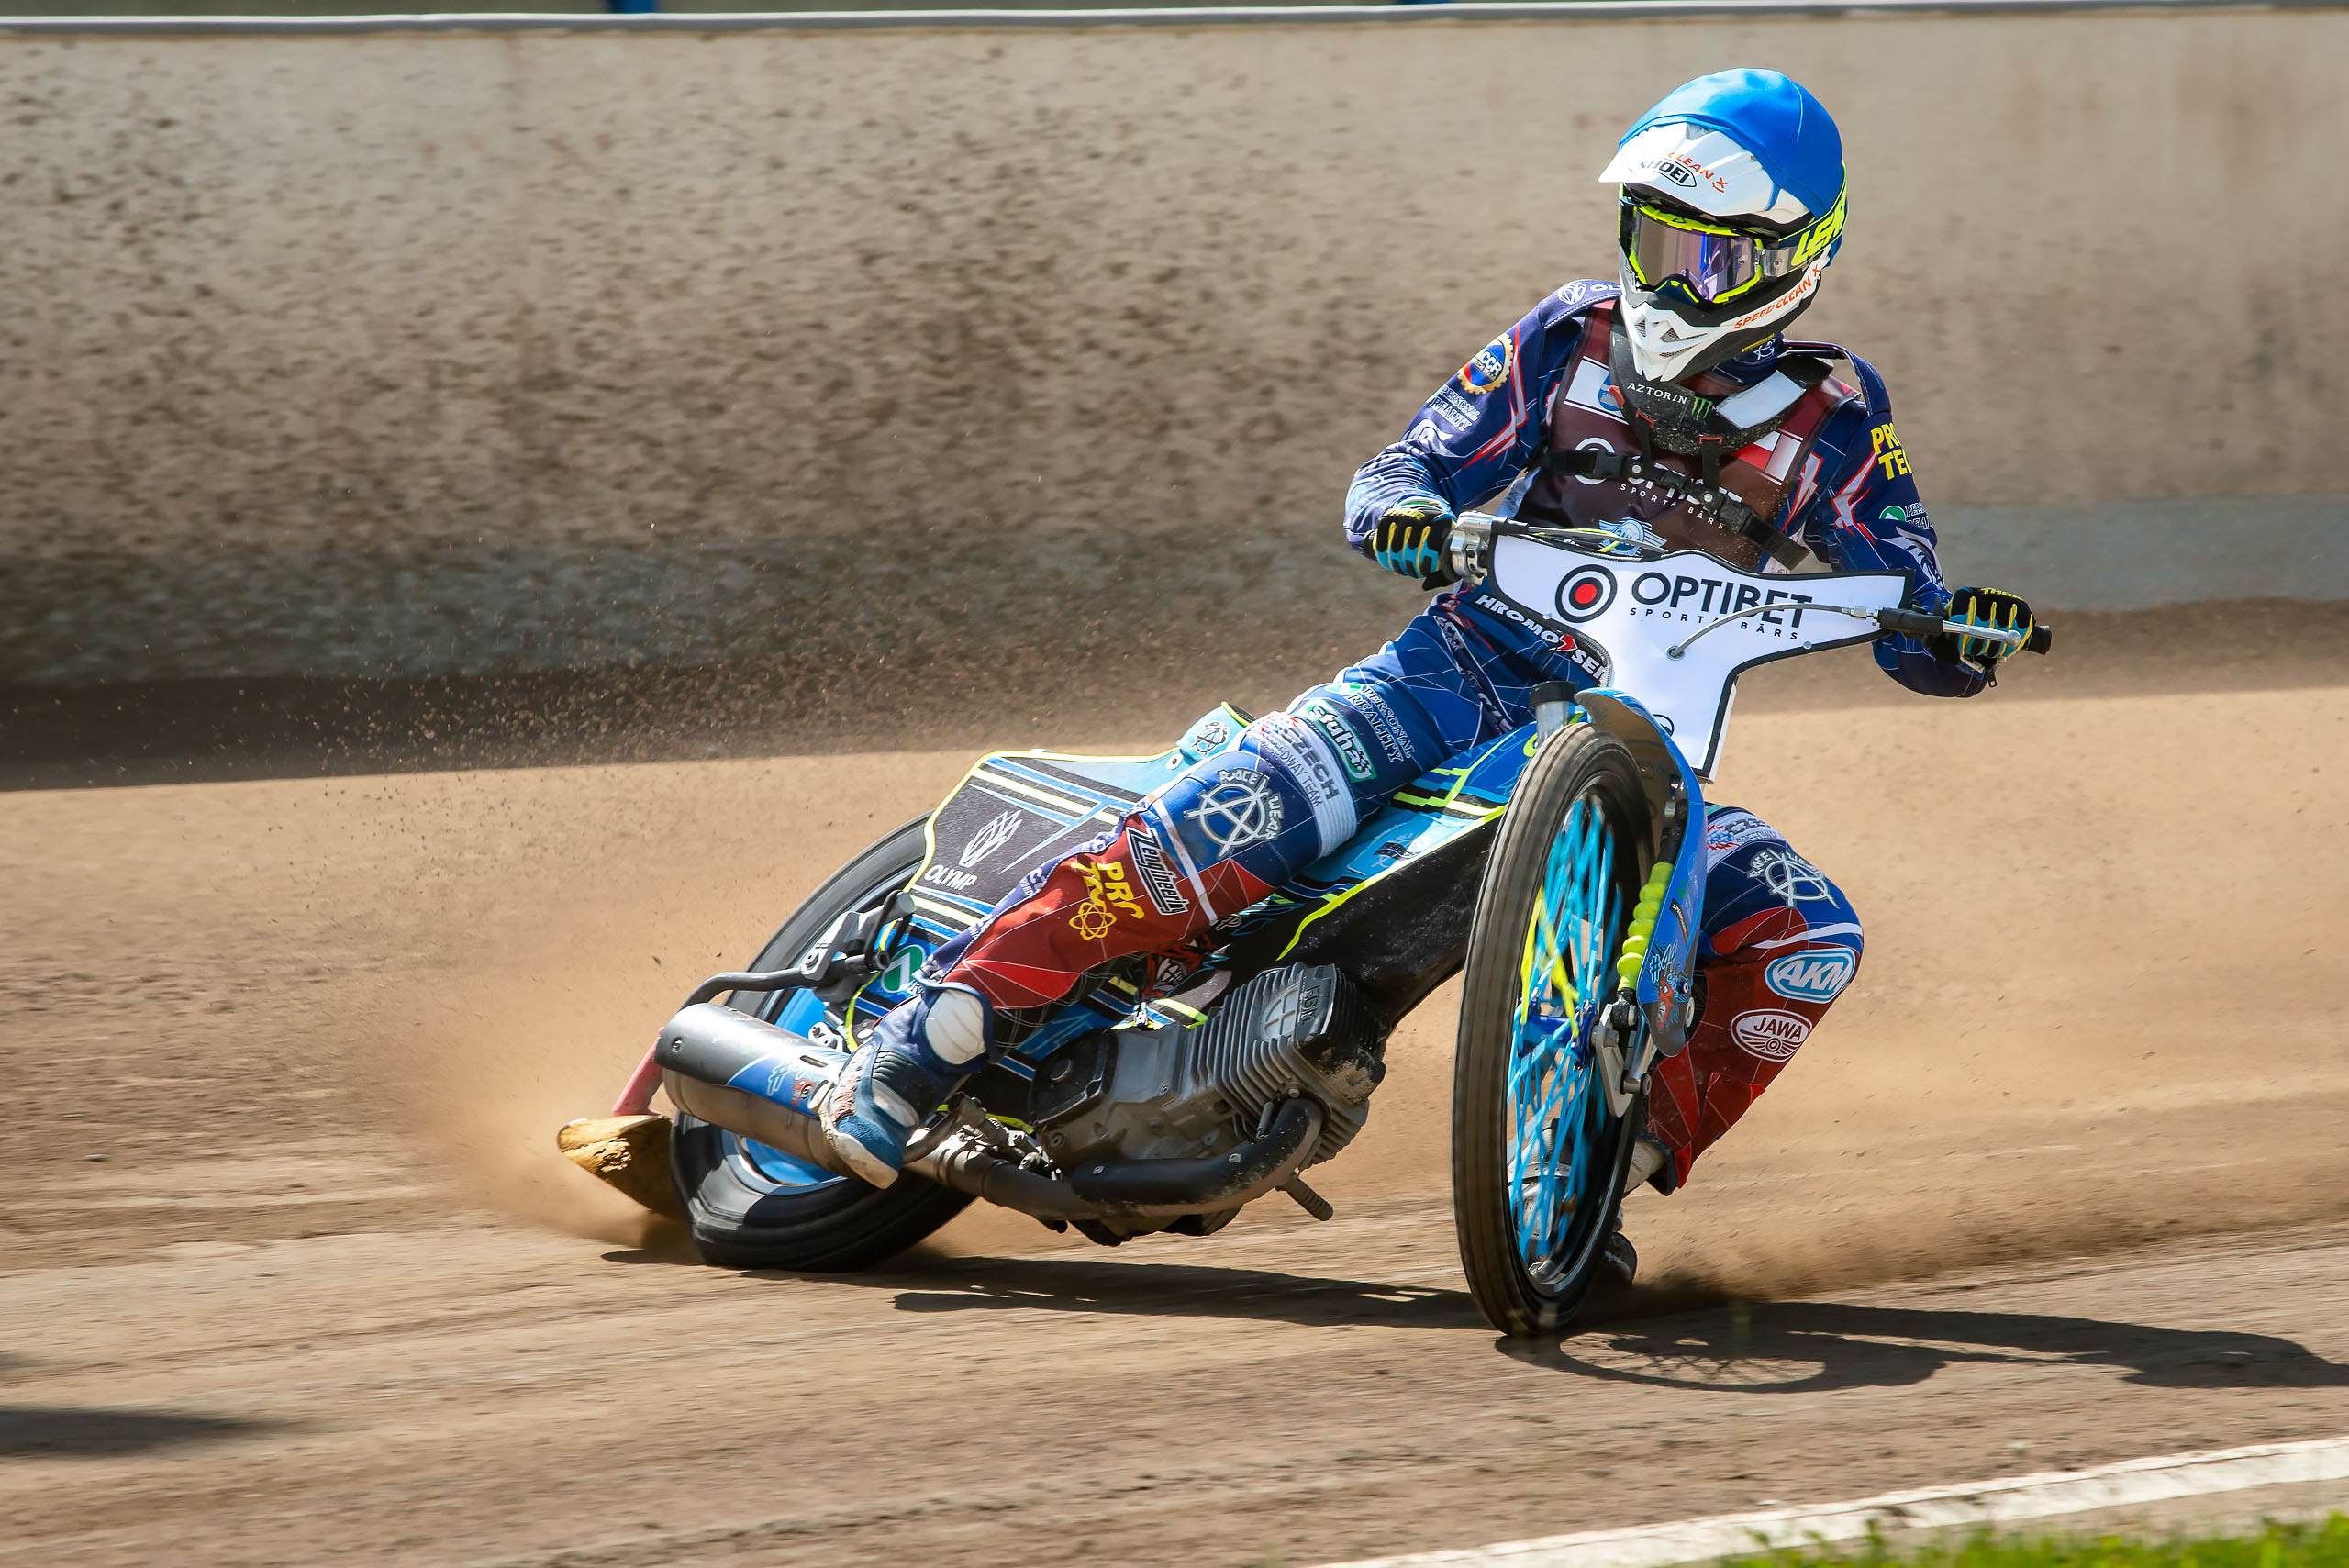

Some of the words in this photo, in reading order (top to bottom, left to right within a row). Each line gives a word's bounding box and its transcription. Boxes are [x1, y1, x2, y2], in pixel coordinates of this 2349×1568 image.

[1733, 278, 1812, 329] SPEEDCLEAN
[1627, 382, 1688, 405] AZTORIN
[1620, 484, 1677, 506] SPORTA
[1631, 571, 1813, 628] OPTIBET
[1740, 622, 1798, 640] BĀRS
[1343, 692, 1405, 763] REALITY
[1362, 687, 1416, 759] PERSONAL
[1280, 727, 1340, 801] CZECH
[1305, 776, 1322, 807] TEAM
[923, 864, 978, 891] OLYMP
[1753, 1017, 1803, 1040] JAWA
